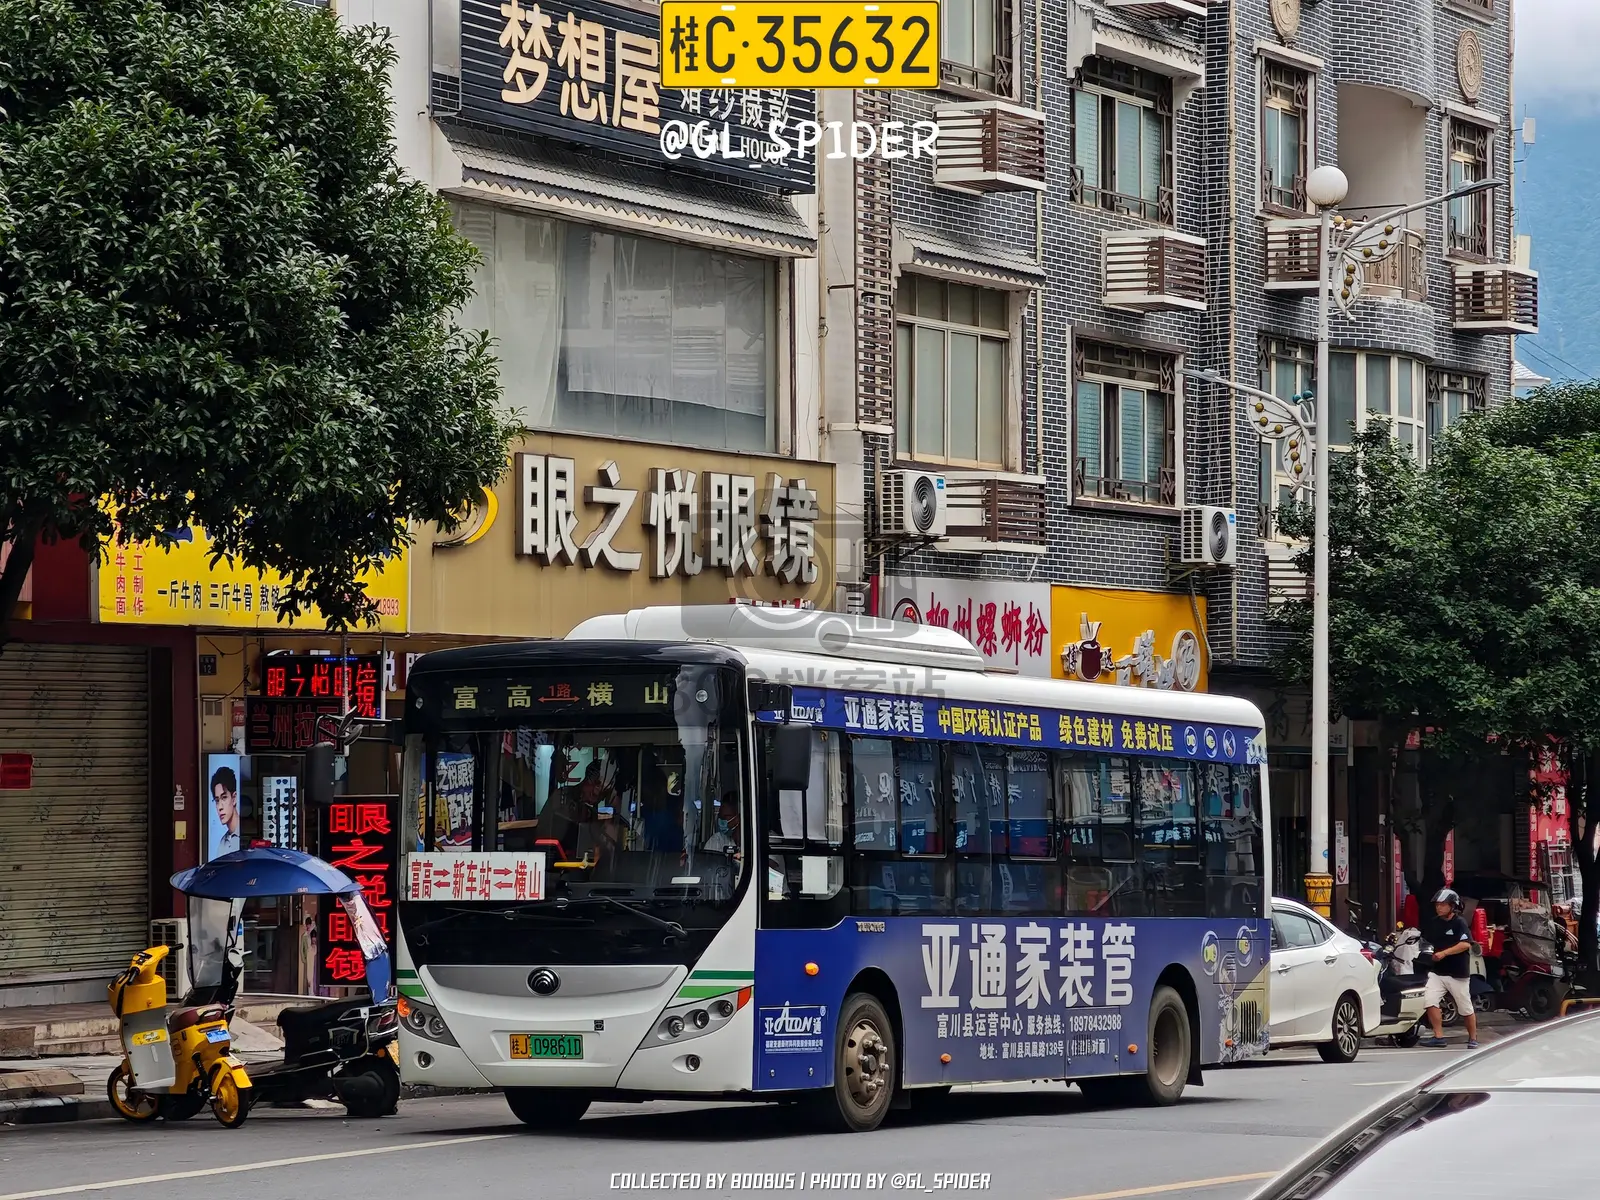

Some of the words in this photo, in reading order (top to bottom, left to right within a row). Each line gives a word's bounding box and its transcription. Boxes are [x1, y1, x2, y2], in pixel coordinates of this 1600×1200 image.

[499, 0, 661, 135] 梦想屋
[515, 452, 820, 585] 眼之悦眼镜
[157, 580, 202, 609] 一斤牛肉
[209, 583, 252, 612] 三斤牛骨
[844, 696, 926, 734] 亚通家装管
[937, 705, 1043, 742] 中国环境认证产品
[1058, 714, 1114, 748] 绿色建材
[1120, 720, 1175, 752] 免费试压
[411, 859, 433, 900] 富高
[452, 859, 492, 901] 新车站
[513, 859, 542, 901] 横山
[920, 921, 1136, 1011] 亚通家装管
[937, 1012, 1024, 1039] 富川县运营中心
